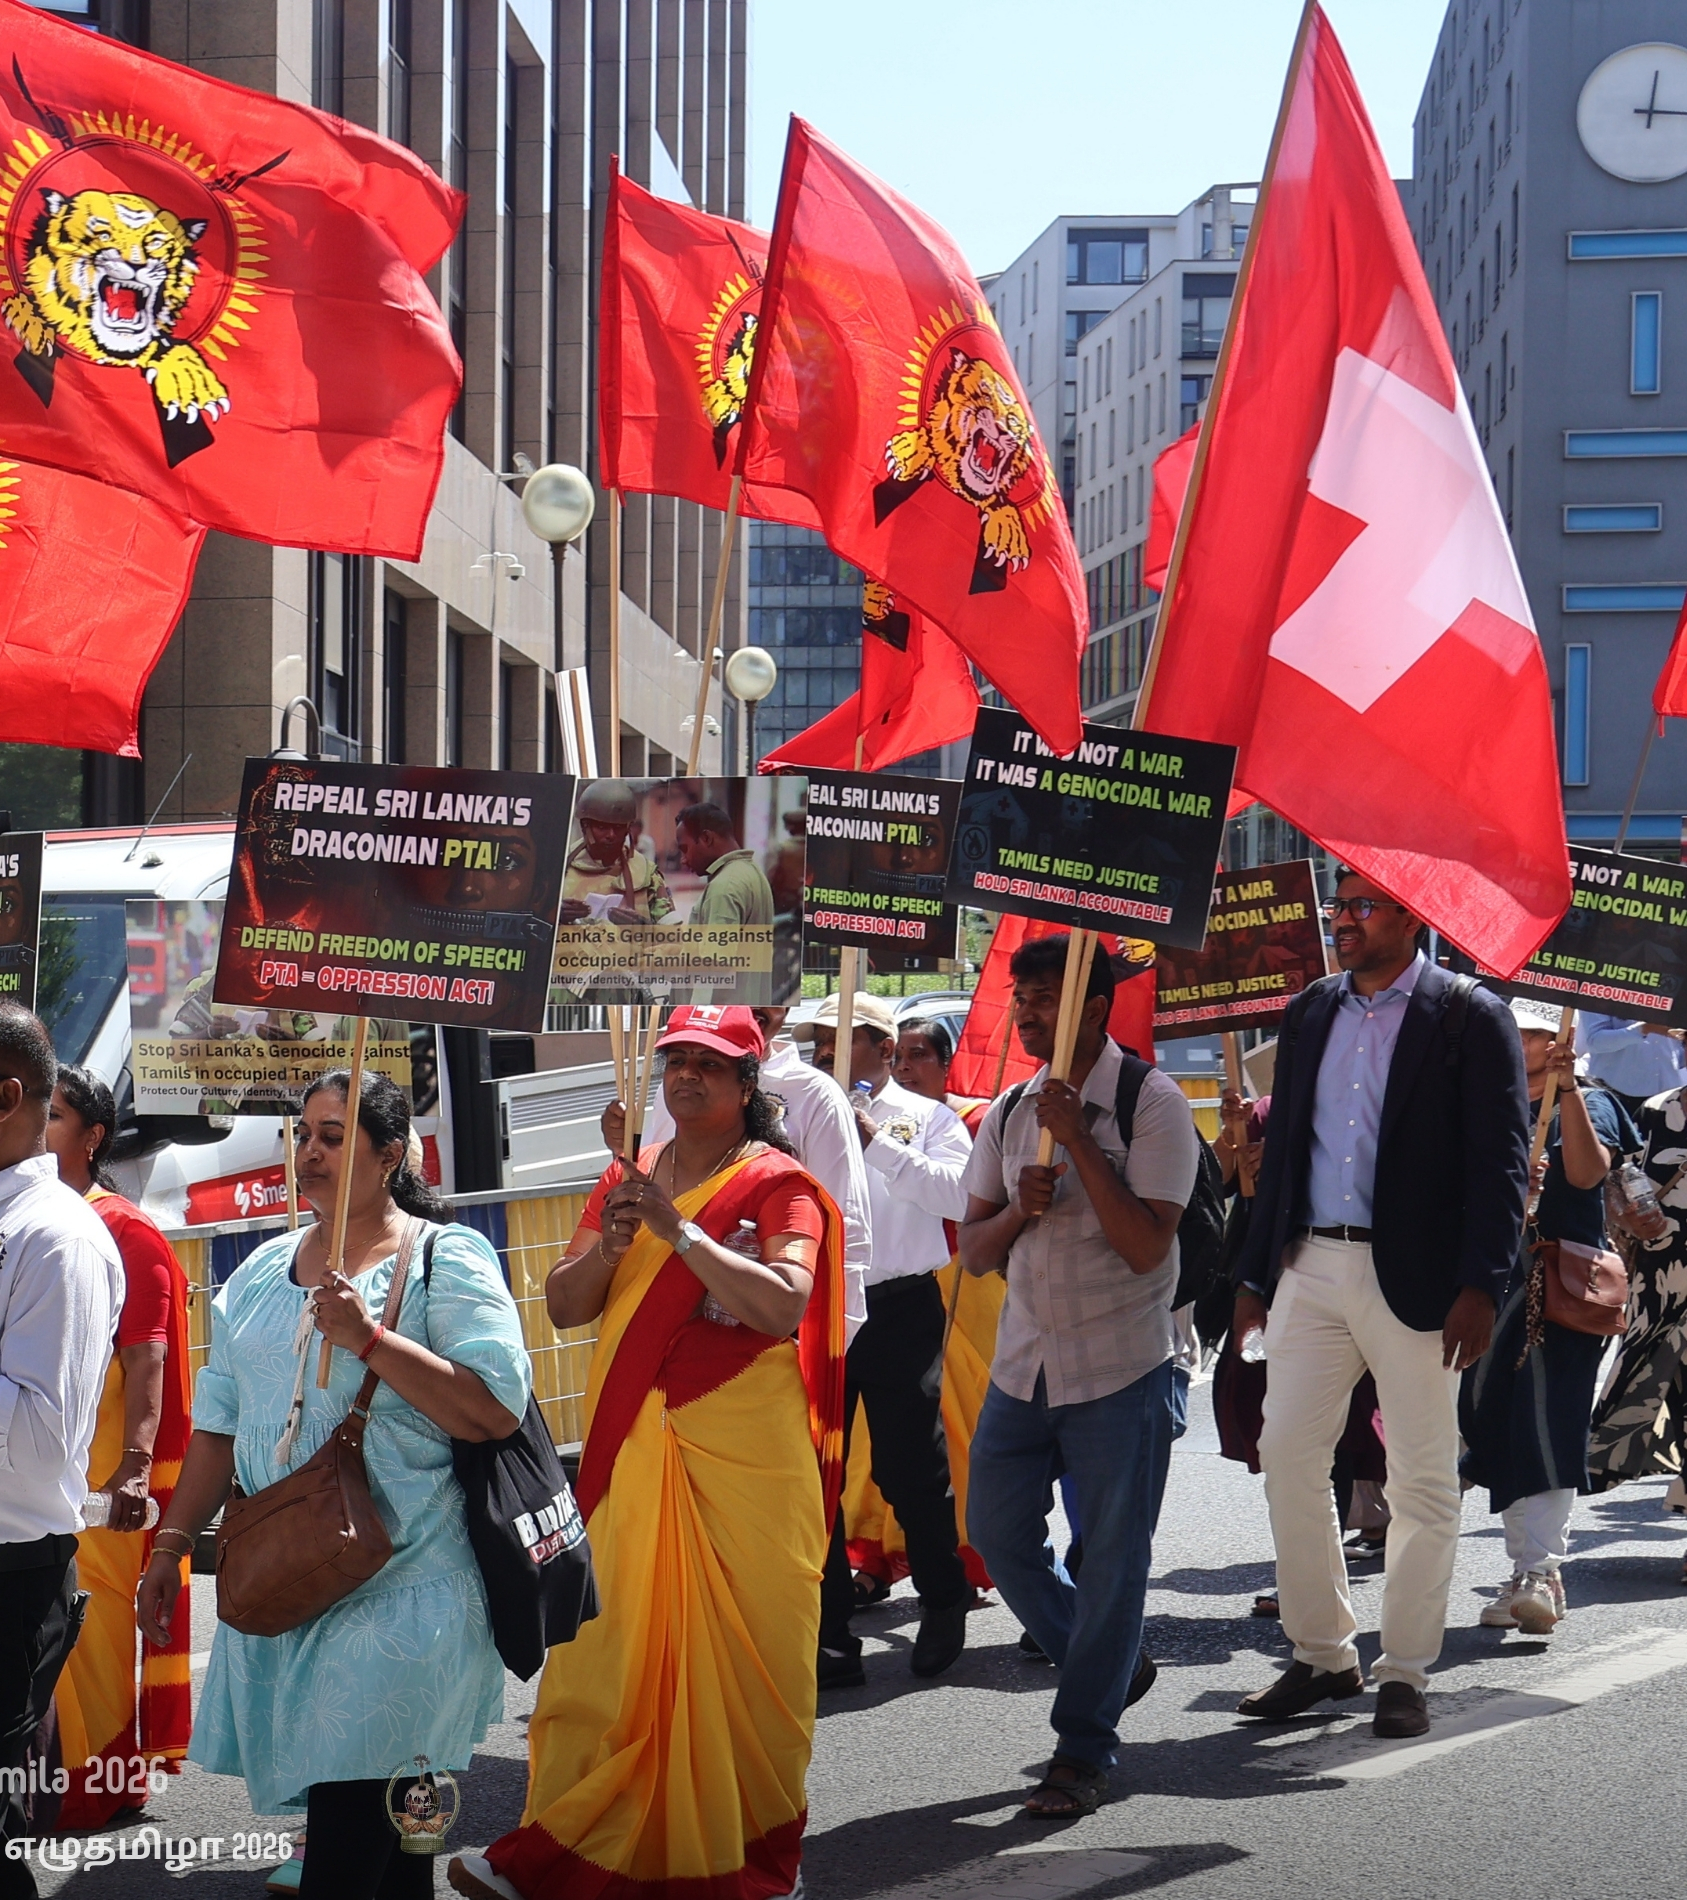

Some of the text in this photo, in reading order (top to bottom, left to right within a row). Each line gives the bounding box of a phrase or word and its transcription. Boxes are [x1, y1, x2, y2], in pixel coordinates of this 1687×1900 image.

[1013, 731, 1031, 752] IT
[1078, 742, 1119, 767] NOT
[1120, 748, 1134, 769] A
[1140, 752, 1185, 779] WAR.
[841, 787, 939, 815] SRI LANKA'S
[976, 759, 1212, 819] IT WAS A GENOCIDAL WAR.
[274, 783, 531, 826] REPEAL SRI LANKA'S
[887, 823, 922, 845] PTA!
[291, 828, 500, 870] DRACONIAN PTA!
[998, 848, 1160, 894] TAMILS NEED JUSTICE.
[1581, 863, 1621, 886] NOT
[1624, 873, 1637, 890] A
[1642, 875, 1686, 899] WAR.
[813, 887, 870, 908] FREEDOM
[873, 894, 889, 910] OF
[892, 896, 943, 916] SPEECH!
[974, 872, 1075, 906] HOLD SRI LANKA
[1239, 880, 1277, 902] WAR.
[814, 910, 925, 939] OPPRESSION ACT!
[1269, 903, 1308, 923] WAR.
[240, 927, 526, 972] DEFEND FREEDOM OF SPEECH!
[620, 929, 773, 947] Genocide against
[559, 953, 751, 970] occupied Tamileelam:
[1554, 955, 1661, 987] NEED JUSTICE.
[260, 961, 495, 1005] PTA OPPRESSION ACT!
[589, 975, 734, 986] Identity, Land, and Future!
[1159, 986, 1200, 1003] TAMILS
[1202, 981, 1234, 998] NEED
[1512, 969, 1534, 984] SRI
[1536, 974, 1577, 992] LANKA
[139, 1043, 345, 1059] Stop Sri Genocide
[140, 1066, 191, 1079] Tamils
[196, 1067, 209, 1079] in
[214, 1067, 287, 1082] occupied
[140, 1087, 177, 1096] Protect
[181, 1087, 198, 1096] Our
[201, 1087, 241, 1097] Culture,
[244, 1087, 285, 1098] Identity,
